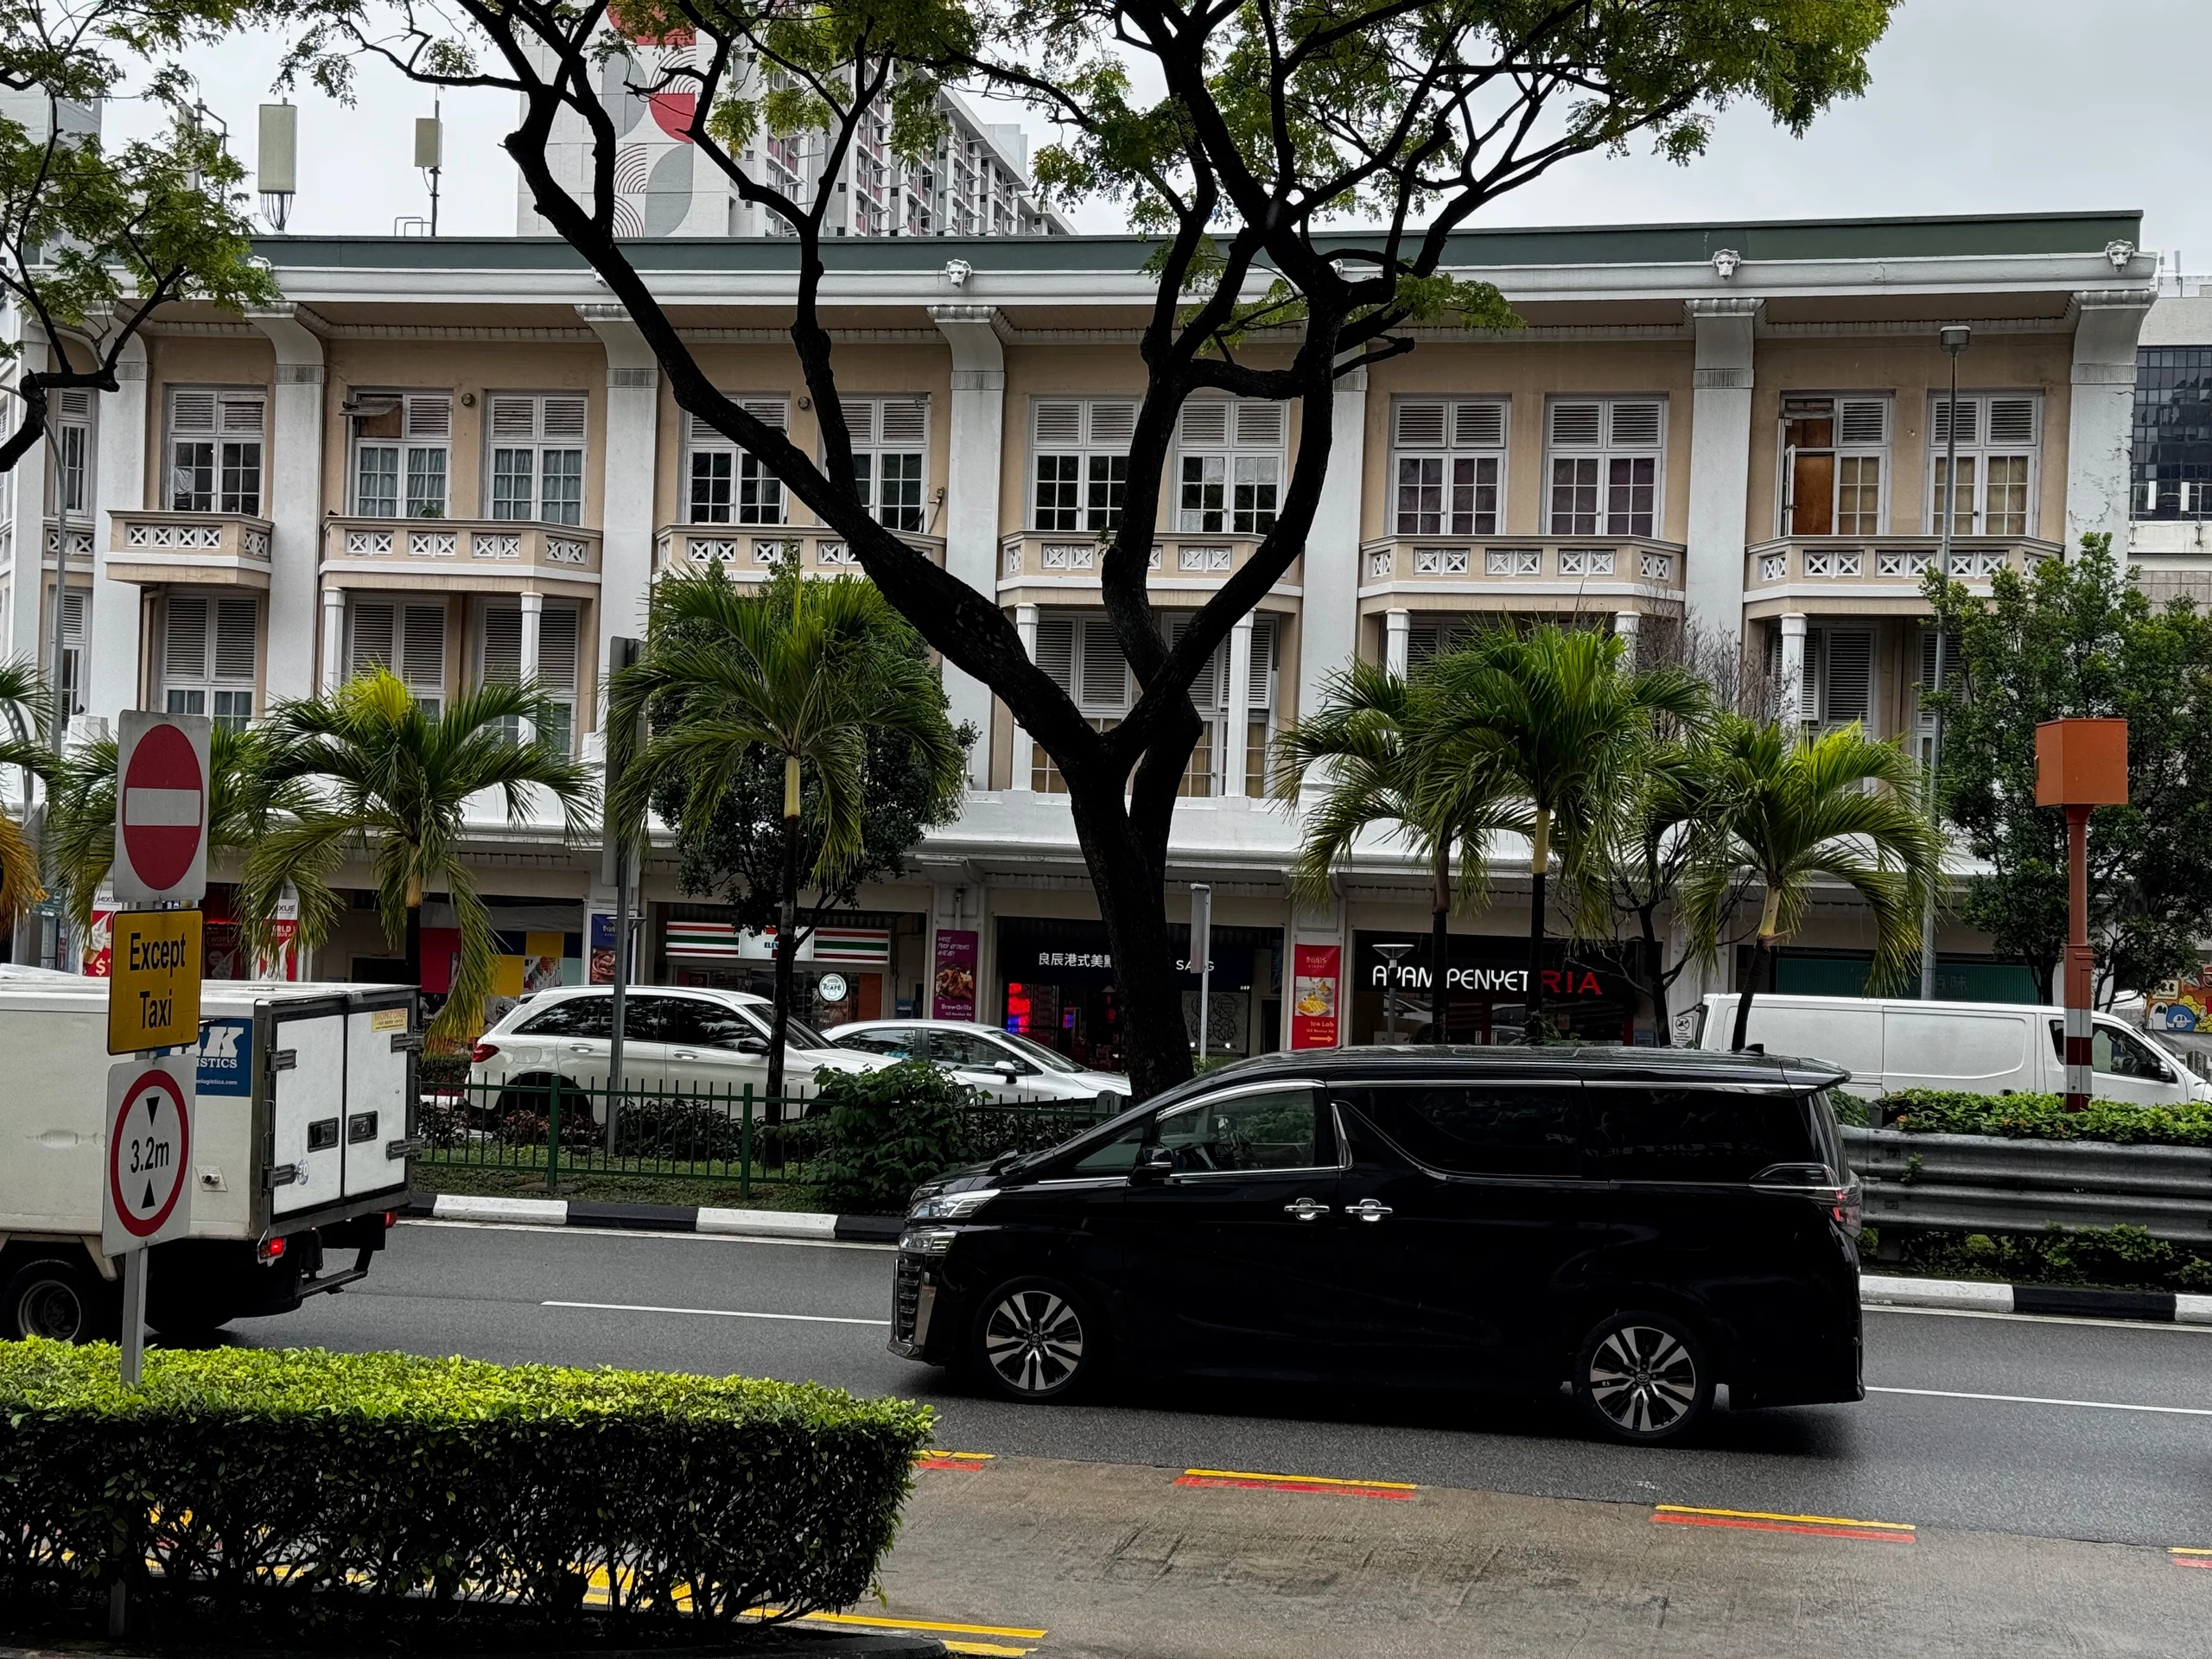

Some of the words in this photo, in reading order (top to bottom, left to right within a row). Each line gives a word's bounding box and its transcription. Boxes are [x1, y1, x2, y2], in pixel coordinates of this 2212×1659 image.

[129, 931, 186, 978] Except
[1446, 968, 1529, 992] PENYET
[1541, 969, 1603, 995] RIA
[139, 988, 172, 1029] Taxi
[196, 1058, 238, 1069] ISTICS
[130, 1136, 169, 1173] 3.2m
